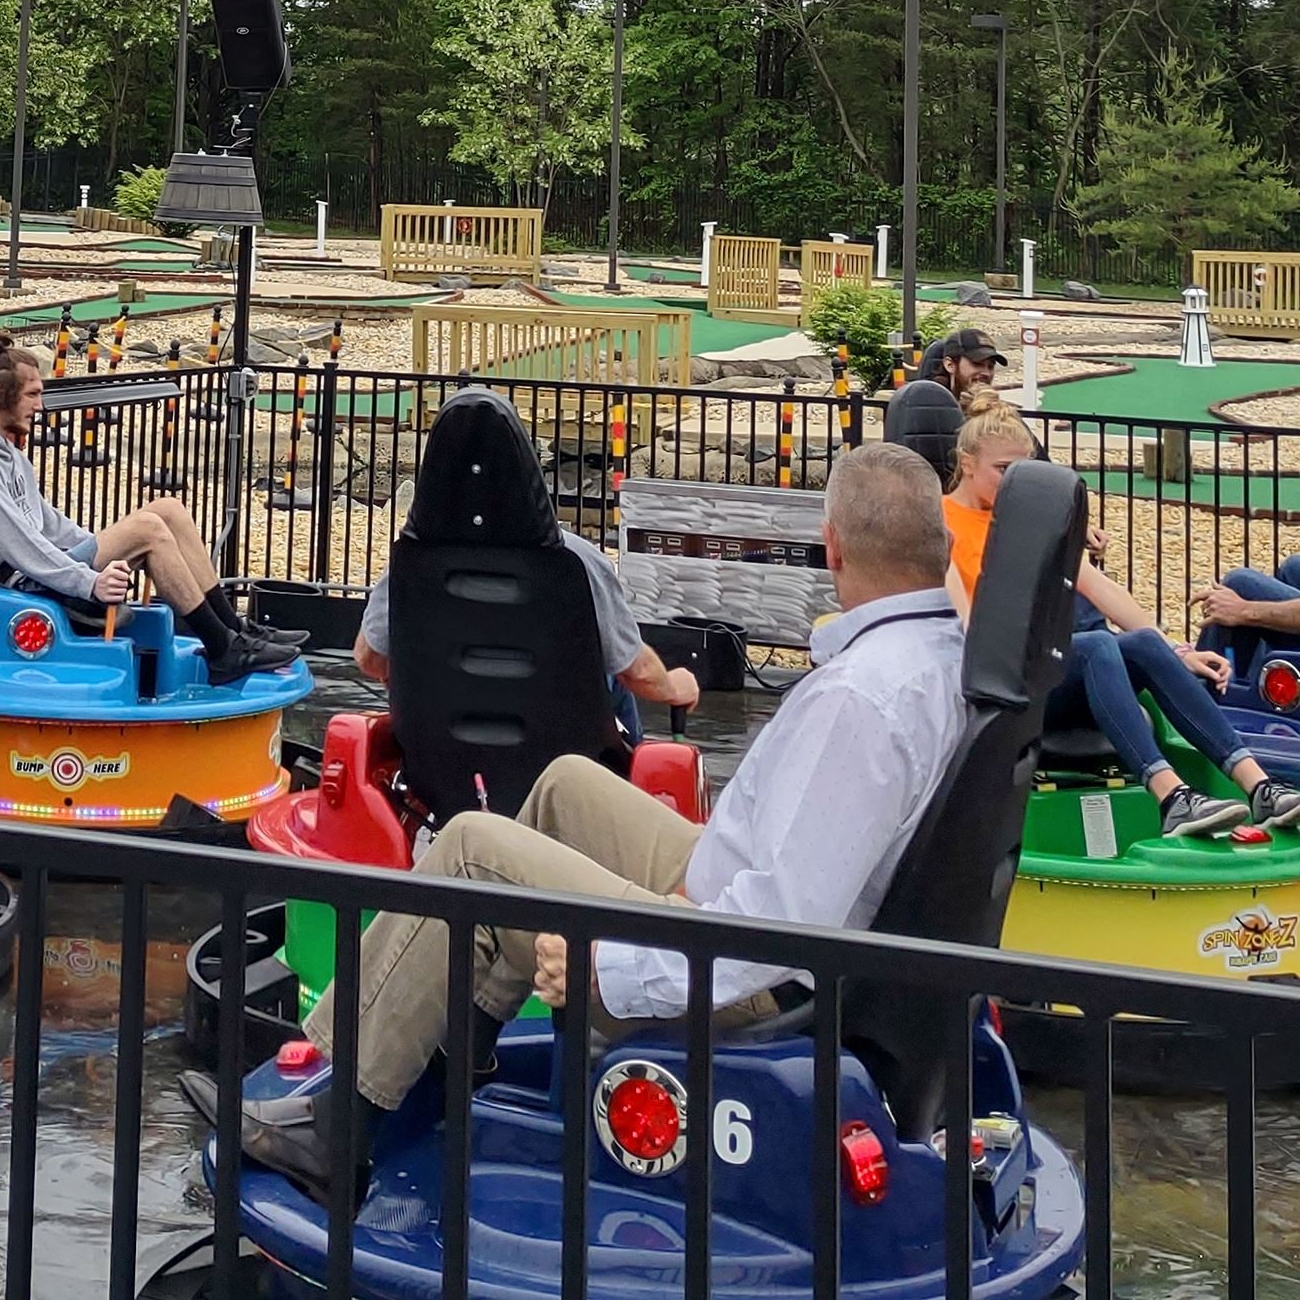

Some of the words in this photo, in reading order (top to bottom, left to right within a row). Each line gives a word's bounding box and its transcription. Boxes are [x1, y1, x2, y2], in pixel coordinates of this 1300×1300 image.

[16, 761, 44, 773] BUMP
[93, 762, 121, 774] HERE
[1203, 929, 1241, 951] SPIN
[713, 1099, 753, 1165] 6
